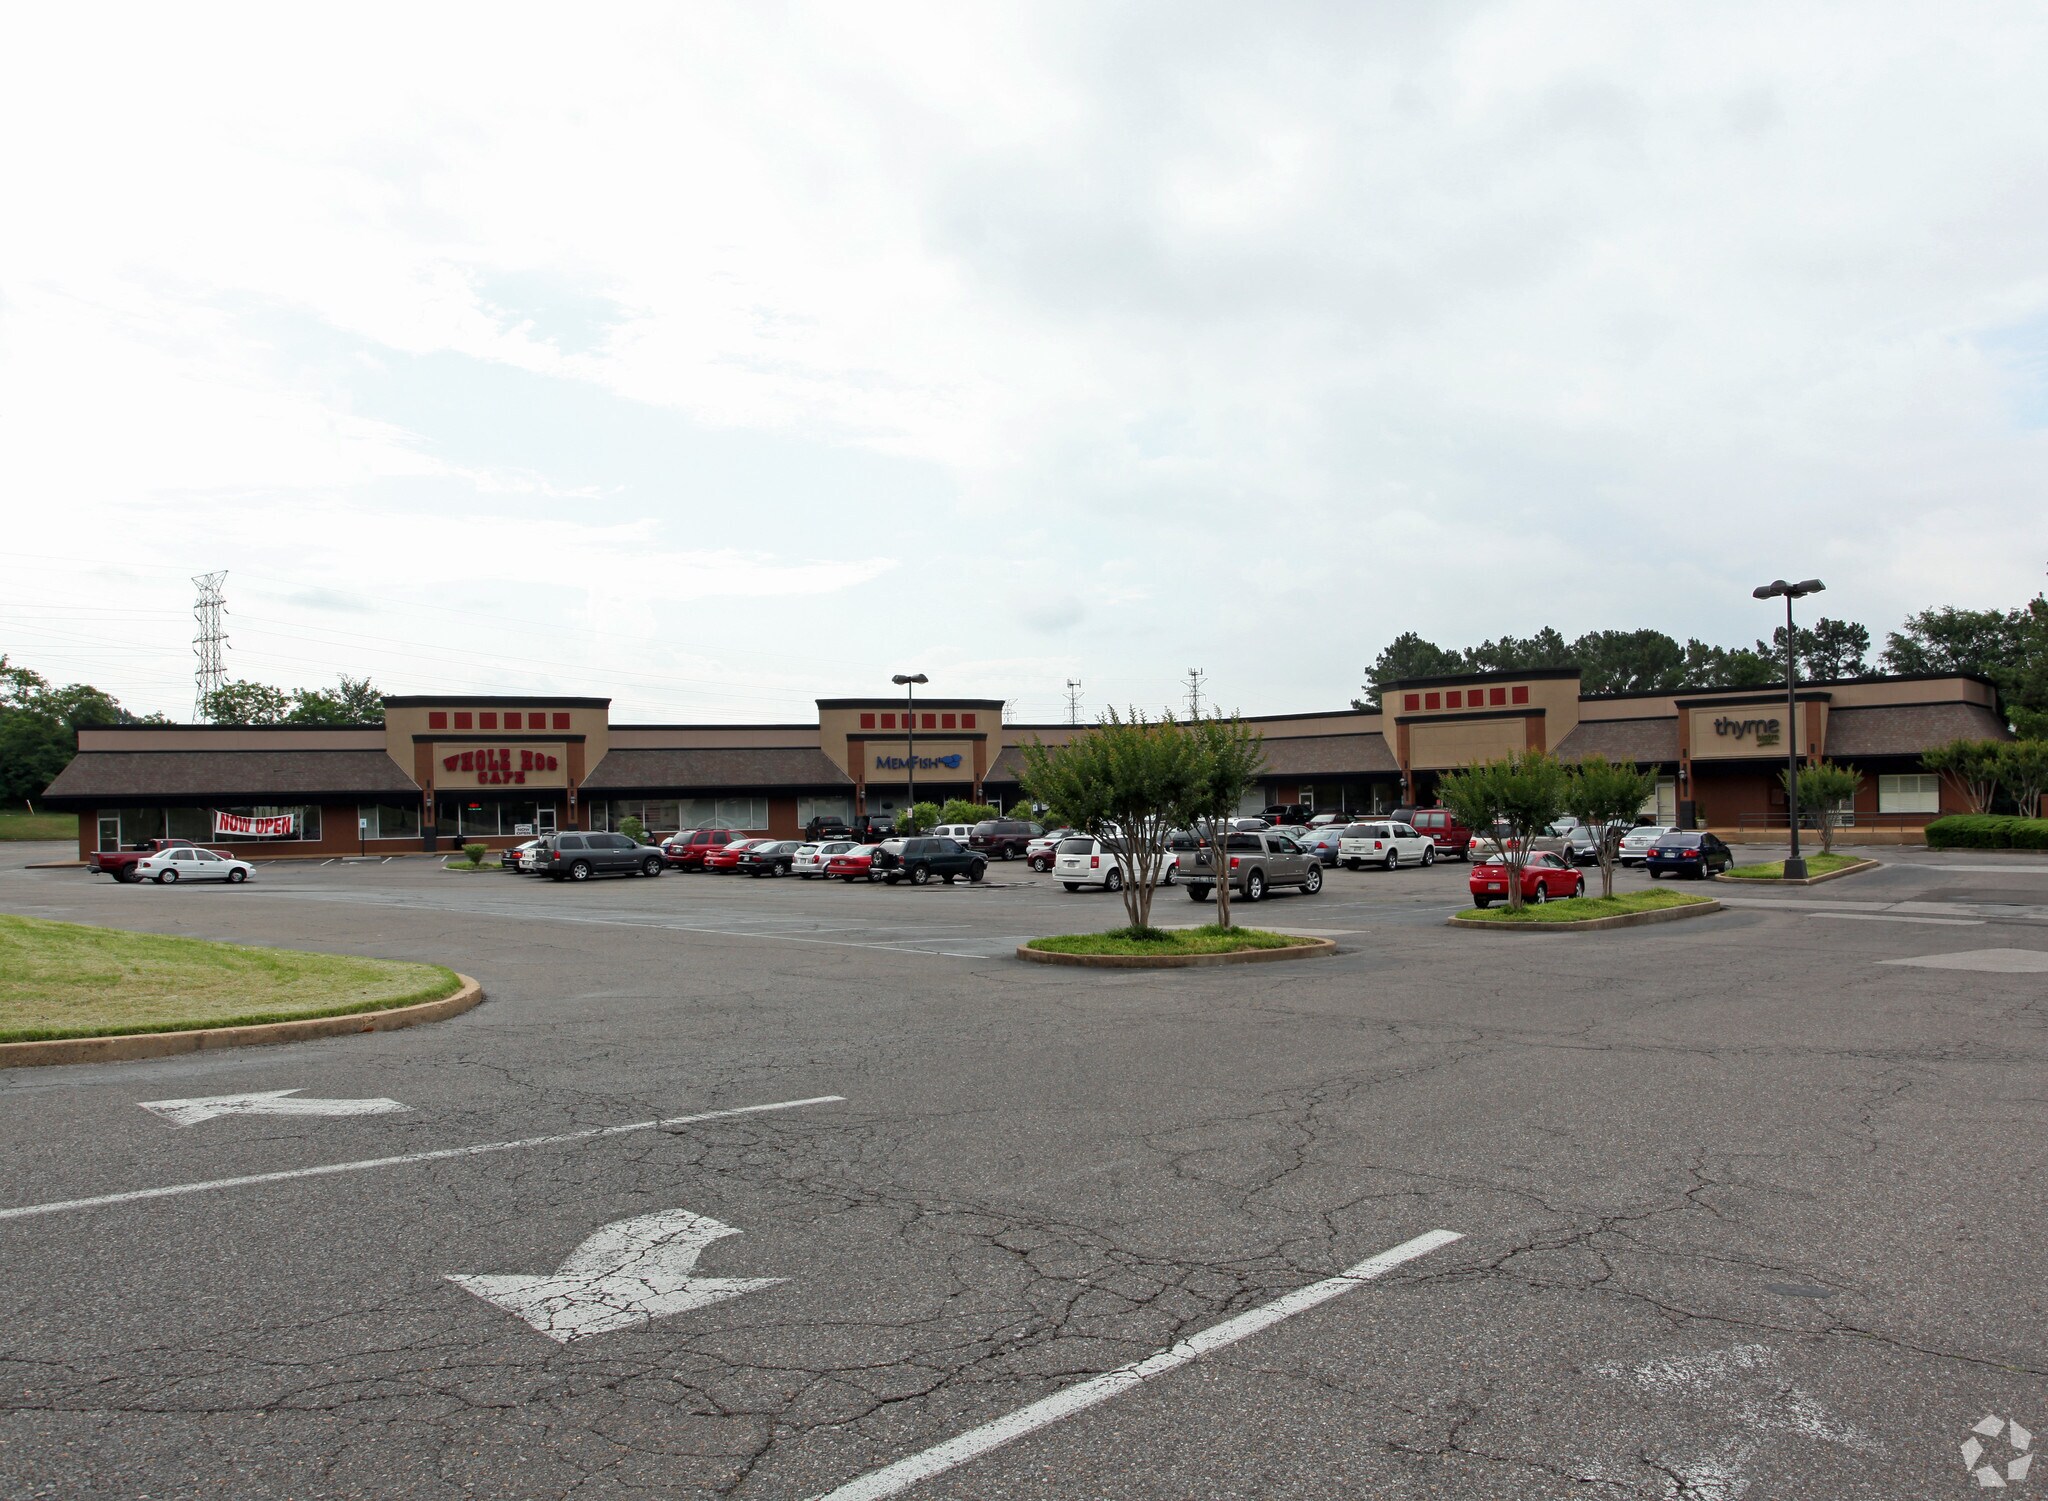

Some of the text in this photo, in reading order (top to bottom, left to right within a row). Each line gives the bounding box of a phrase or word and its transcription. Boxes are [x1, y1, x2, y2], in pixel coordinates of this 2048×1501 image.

[1714, 716, 1779, 740] thyme
[443, 749, 558, 772] WHOLE HOG
[220, 813, 291, 834] NOW OPEN
